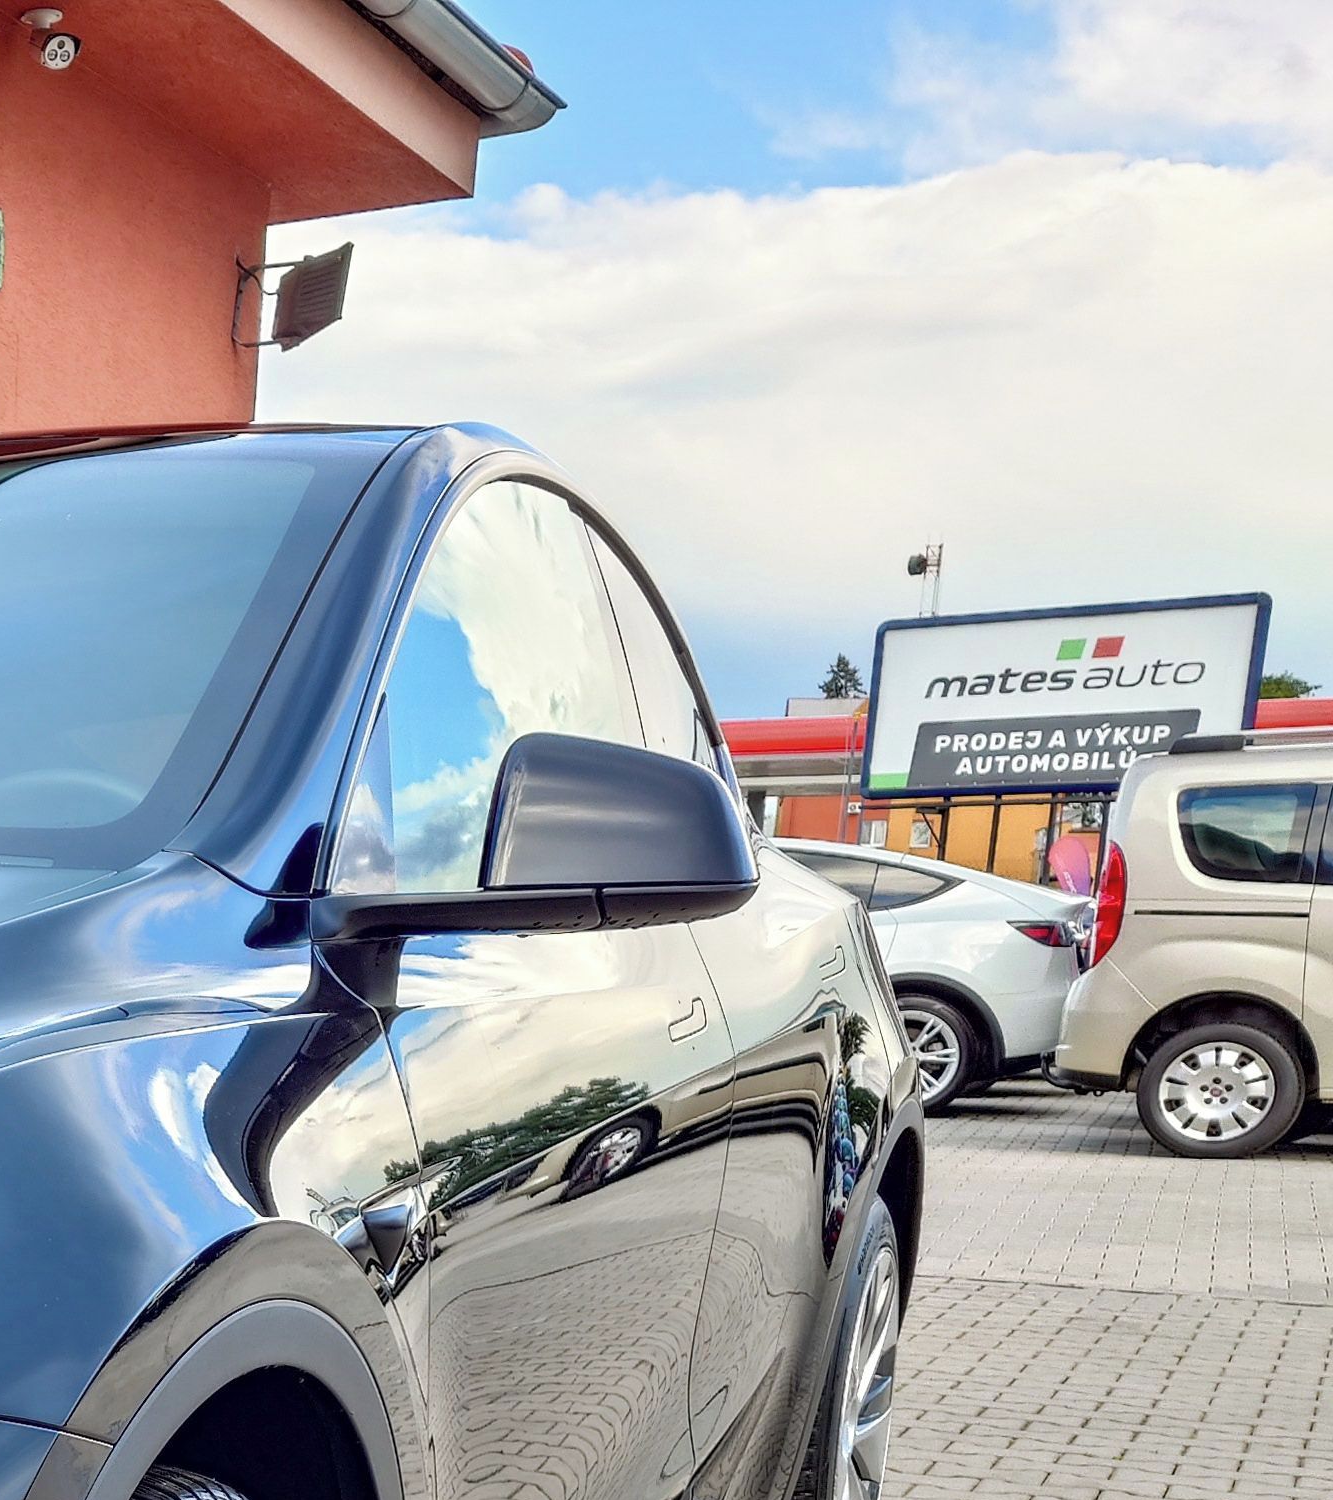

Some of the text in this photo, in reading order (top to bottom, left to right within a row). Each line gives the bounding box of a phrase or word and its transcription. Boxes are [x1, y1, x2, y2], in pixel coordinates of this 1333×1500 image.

[924, 658, 1206, 700] mates auto
[934, 722, 1171, 754] PRODEJ A VÝKUP
[954, 745, 1137, 776] AUTOMOBILŮ
